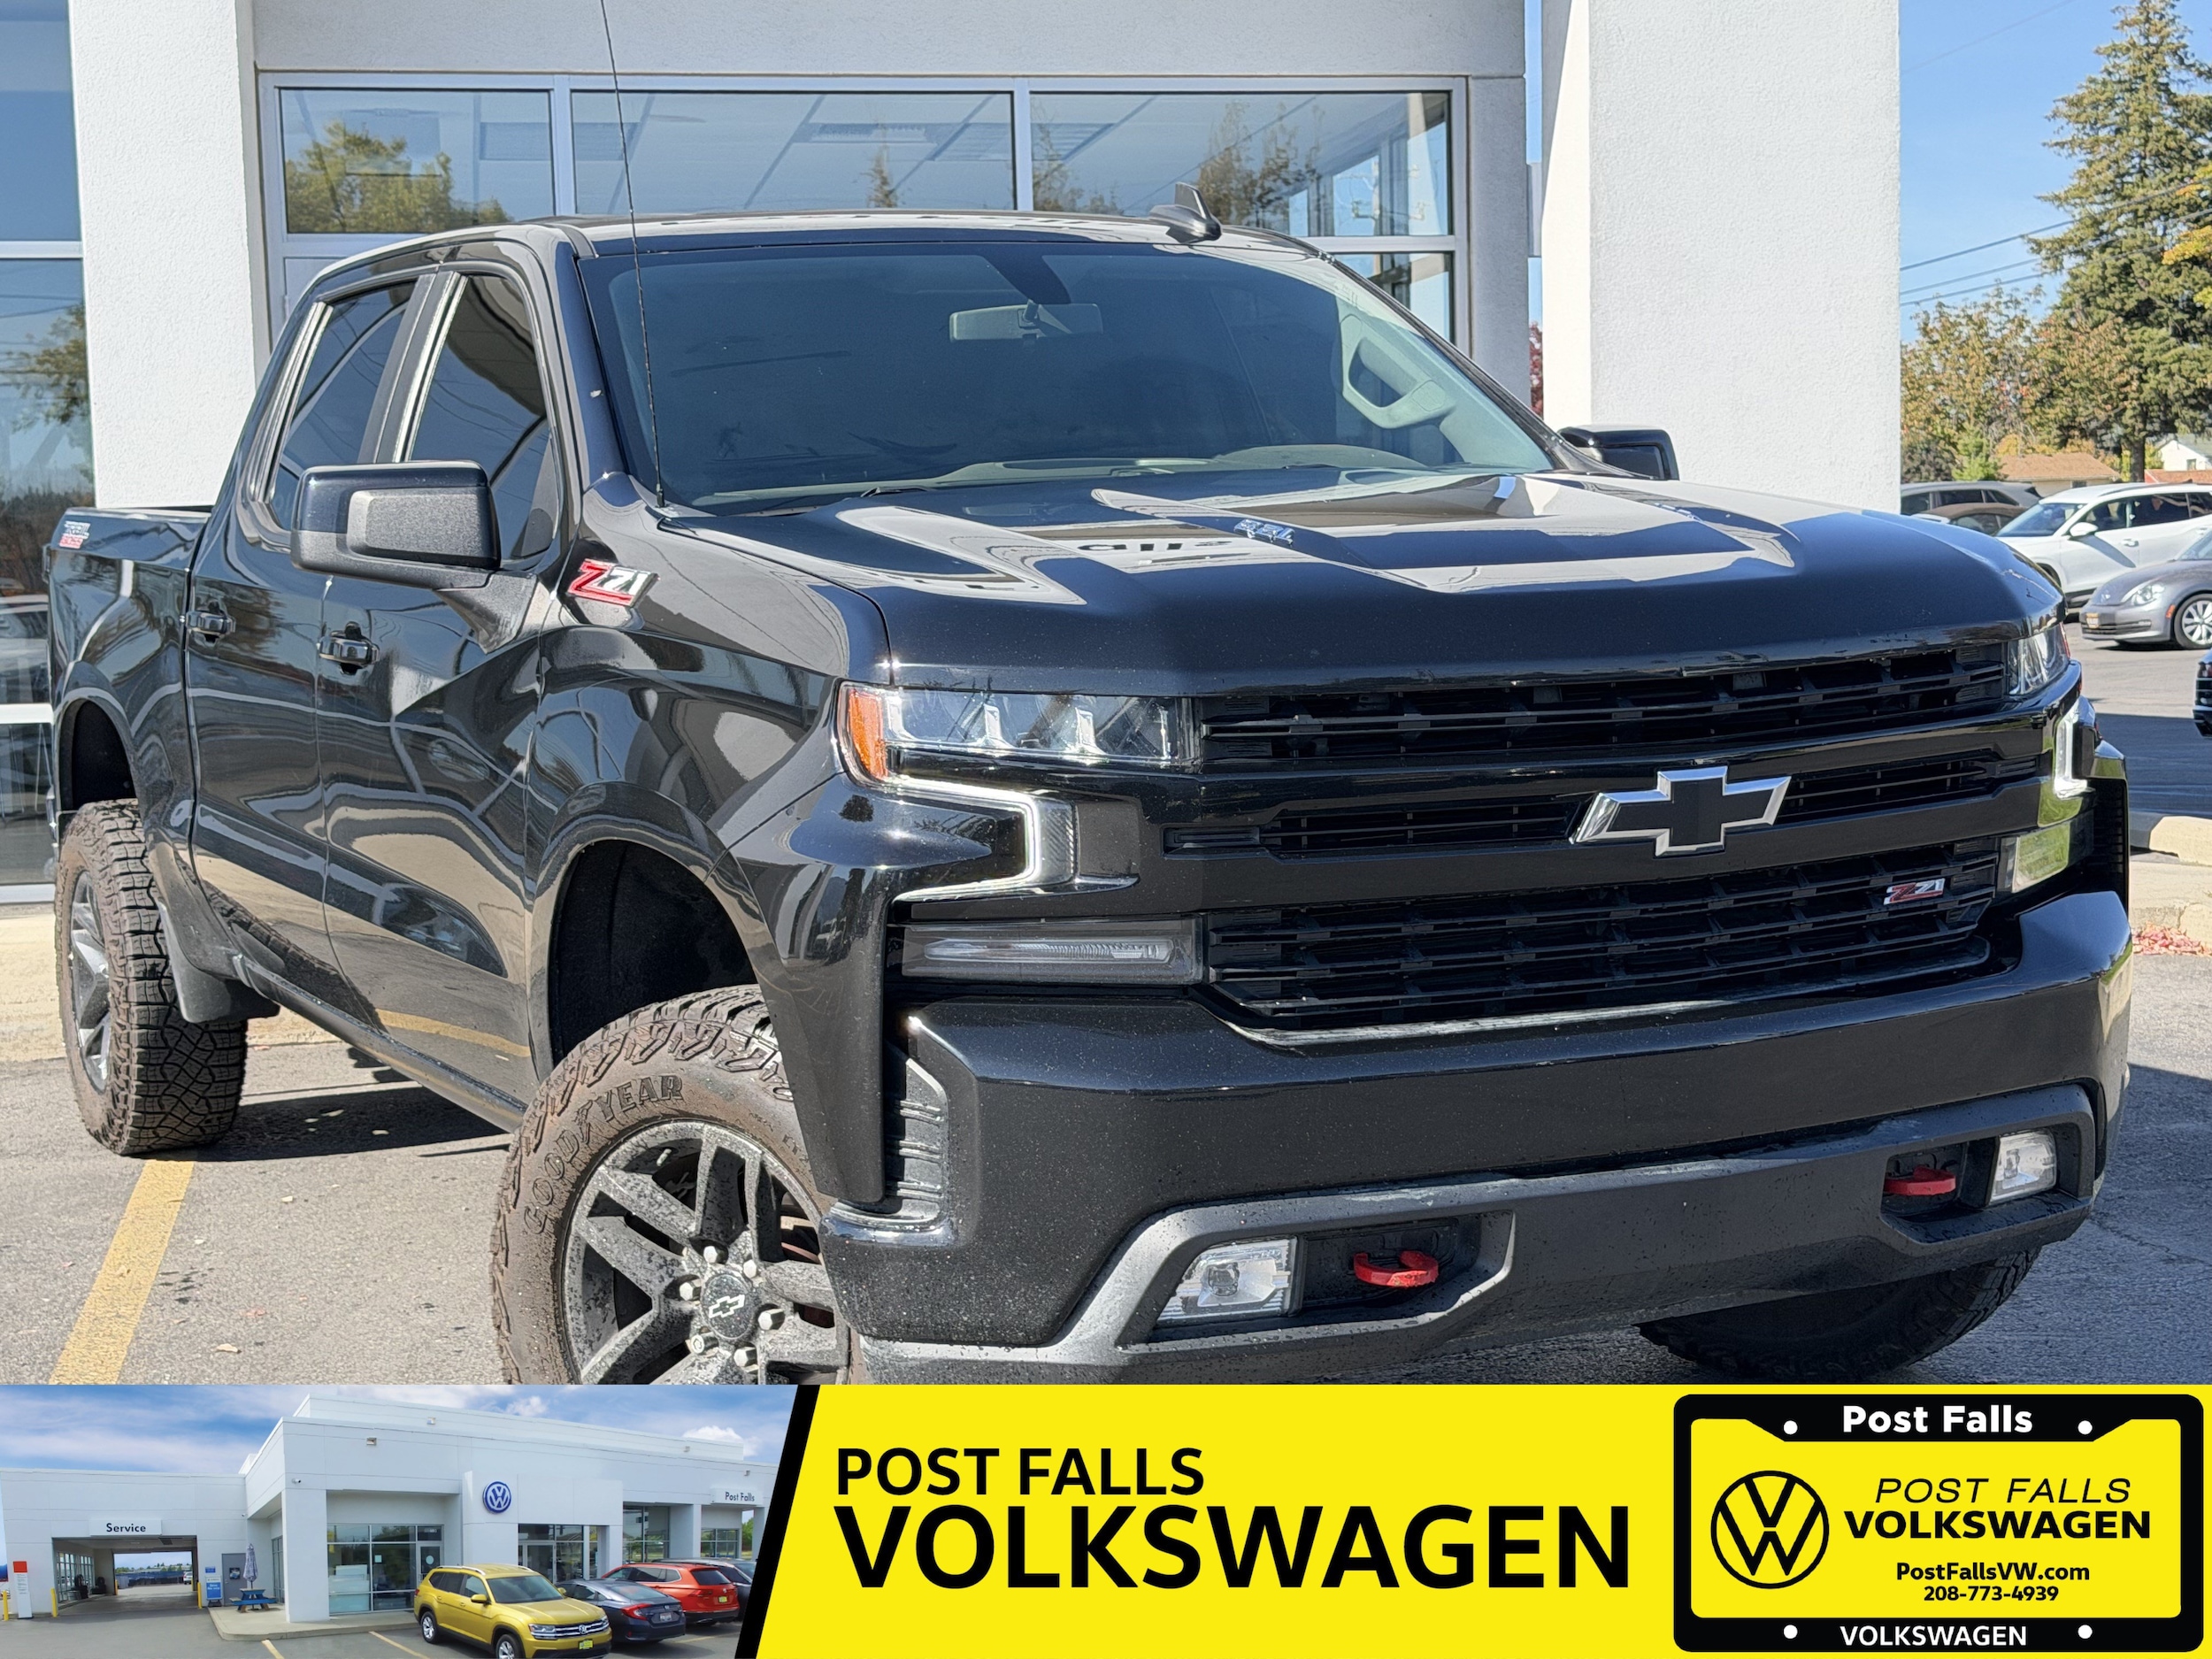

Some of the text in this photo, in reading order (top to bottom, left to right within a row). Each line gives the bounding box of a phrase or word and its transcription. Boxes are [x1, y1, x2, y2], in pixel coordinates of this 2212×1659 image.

[567, 557, 657, 607] Z71
[1883, 878, 1946, 906] Z71
[523, 1074, 685, 1235] GOODYEAR
